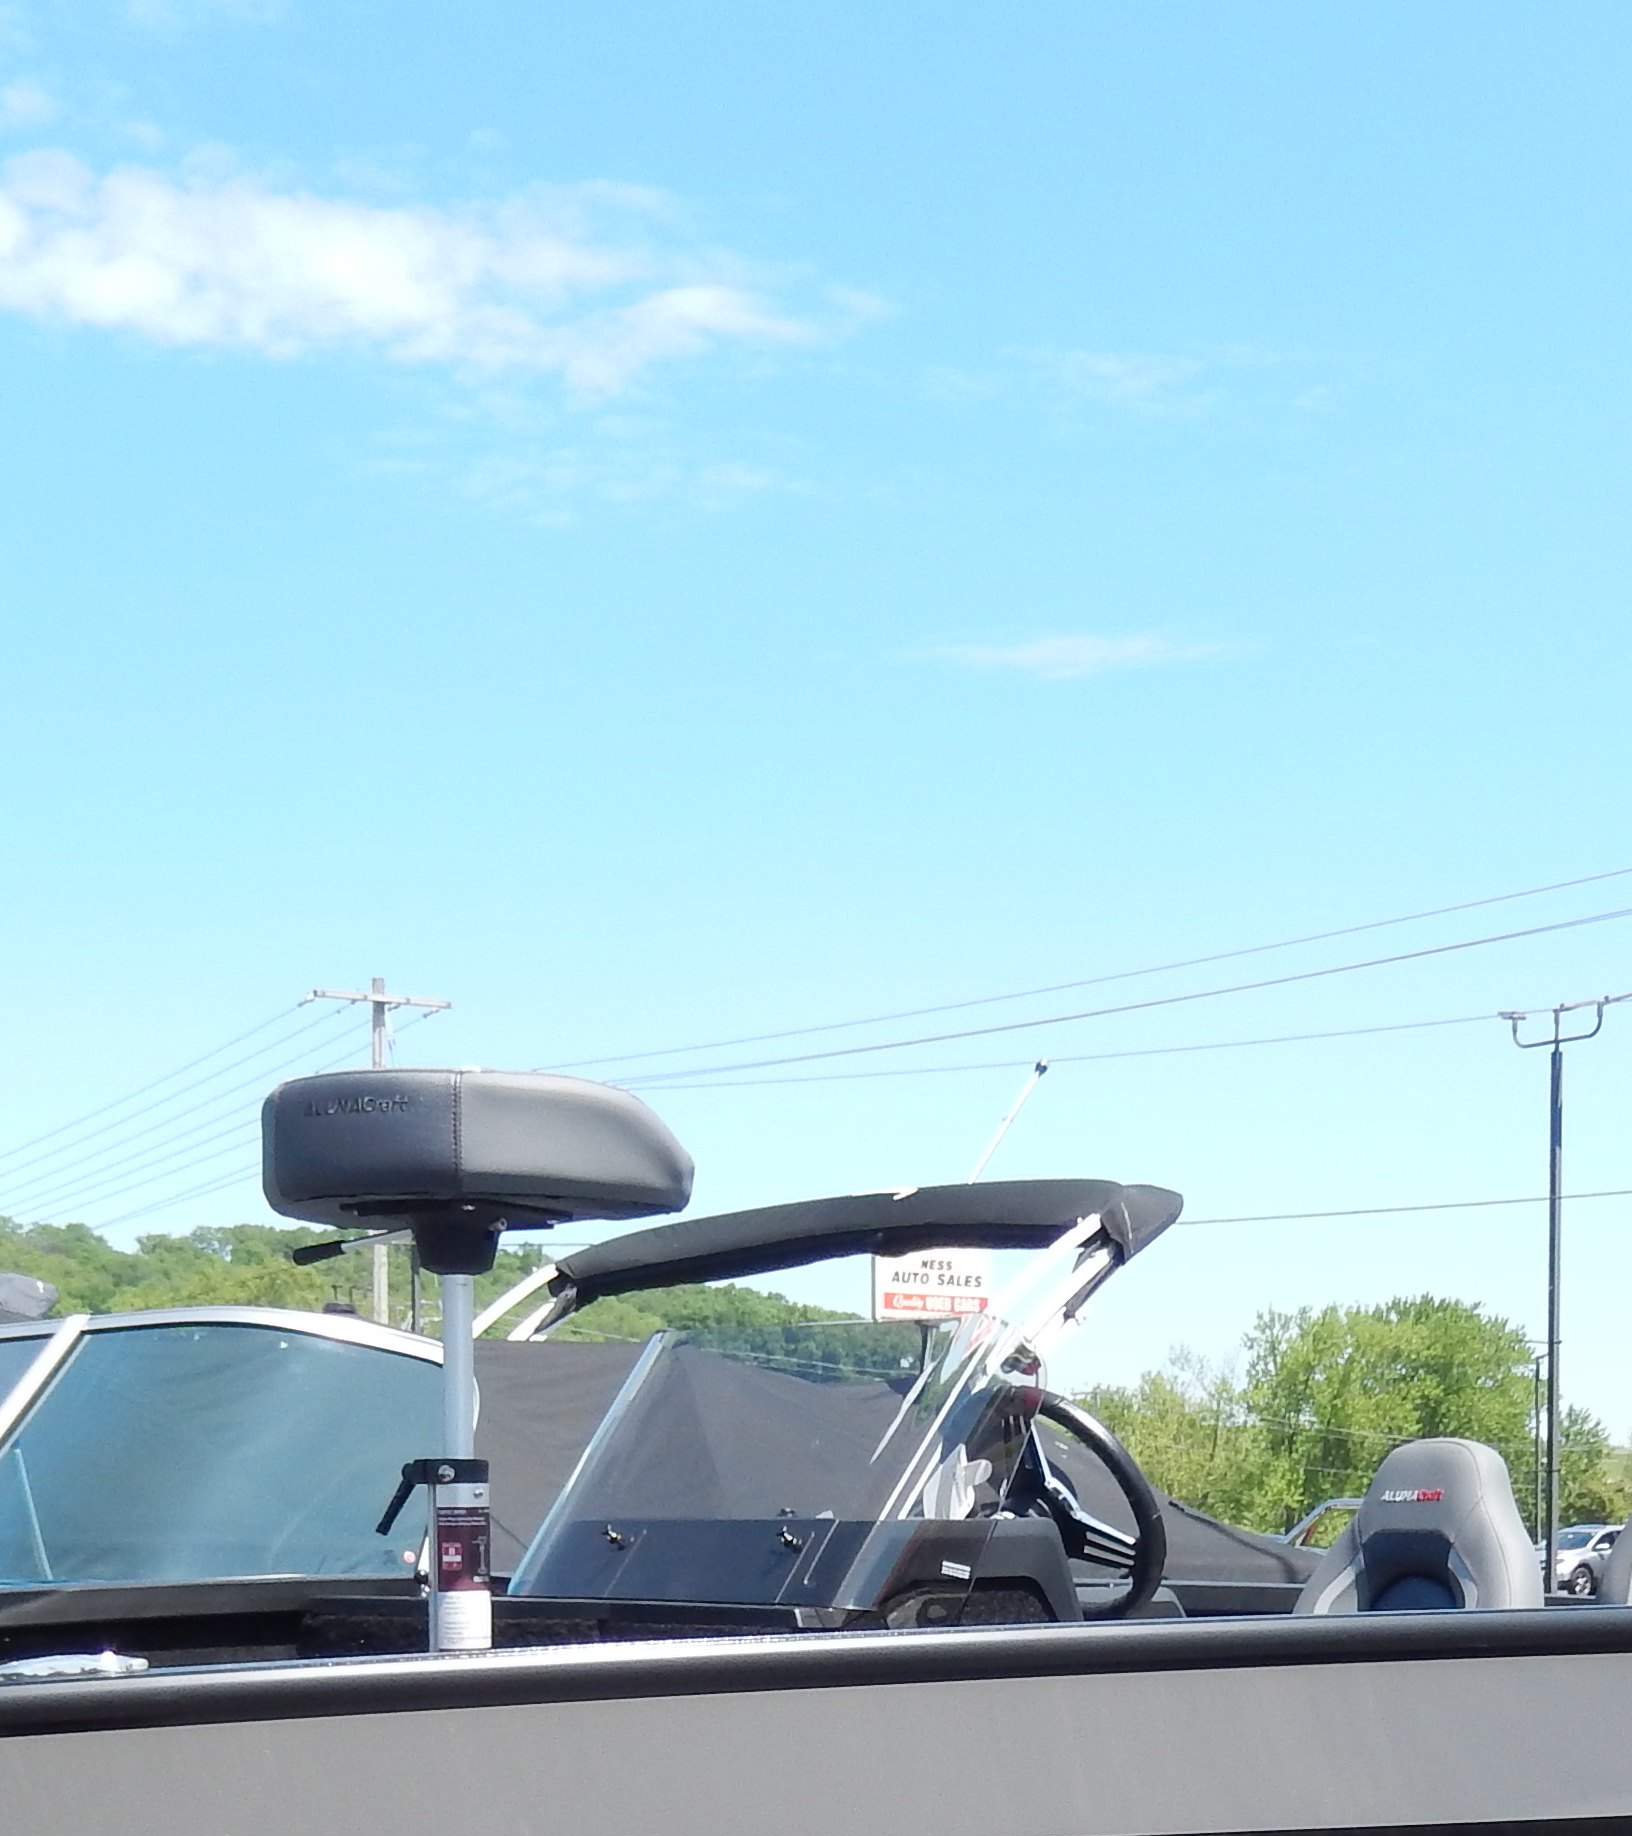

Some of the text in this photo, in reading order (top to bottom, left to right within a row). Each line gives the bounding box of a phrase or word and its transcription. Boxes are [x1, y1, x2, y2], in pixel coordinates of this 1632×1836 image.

[921, 1260, 952, 1270] NESS
[892, 1271, 982, 1288] AUTO SALES
